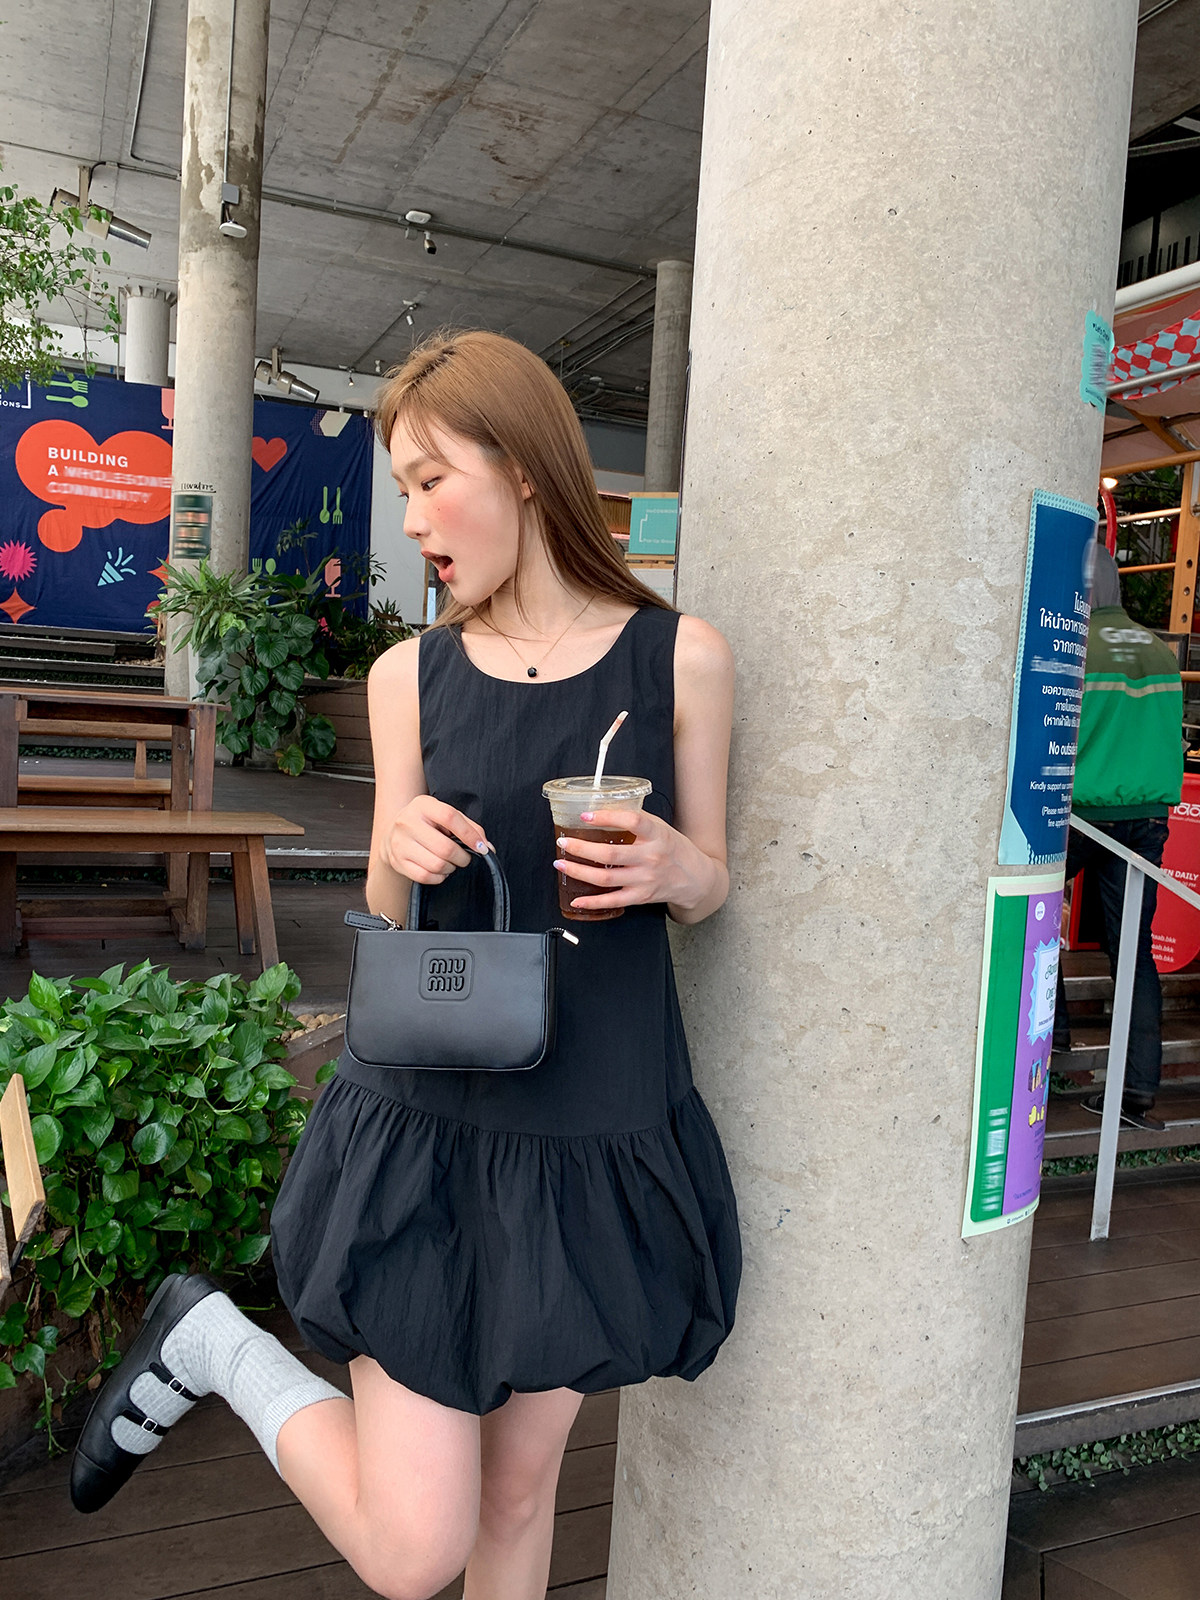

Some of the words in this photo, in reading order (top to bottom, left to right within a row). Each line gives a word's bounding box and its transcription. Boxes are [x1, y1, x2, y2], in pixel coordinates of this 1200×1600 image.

[47, 446, 129, 469] BUILDING
[47, 464, 59, 477] A
[1048, 741, 1060, 755] No
[1029, 781, 1046, 792] Kindly
[1046, 782, 1062, 791] support
[1041, 806, 1057, 817] (Please
[1174, 870, 1199, 881] DAILY
